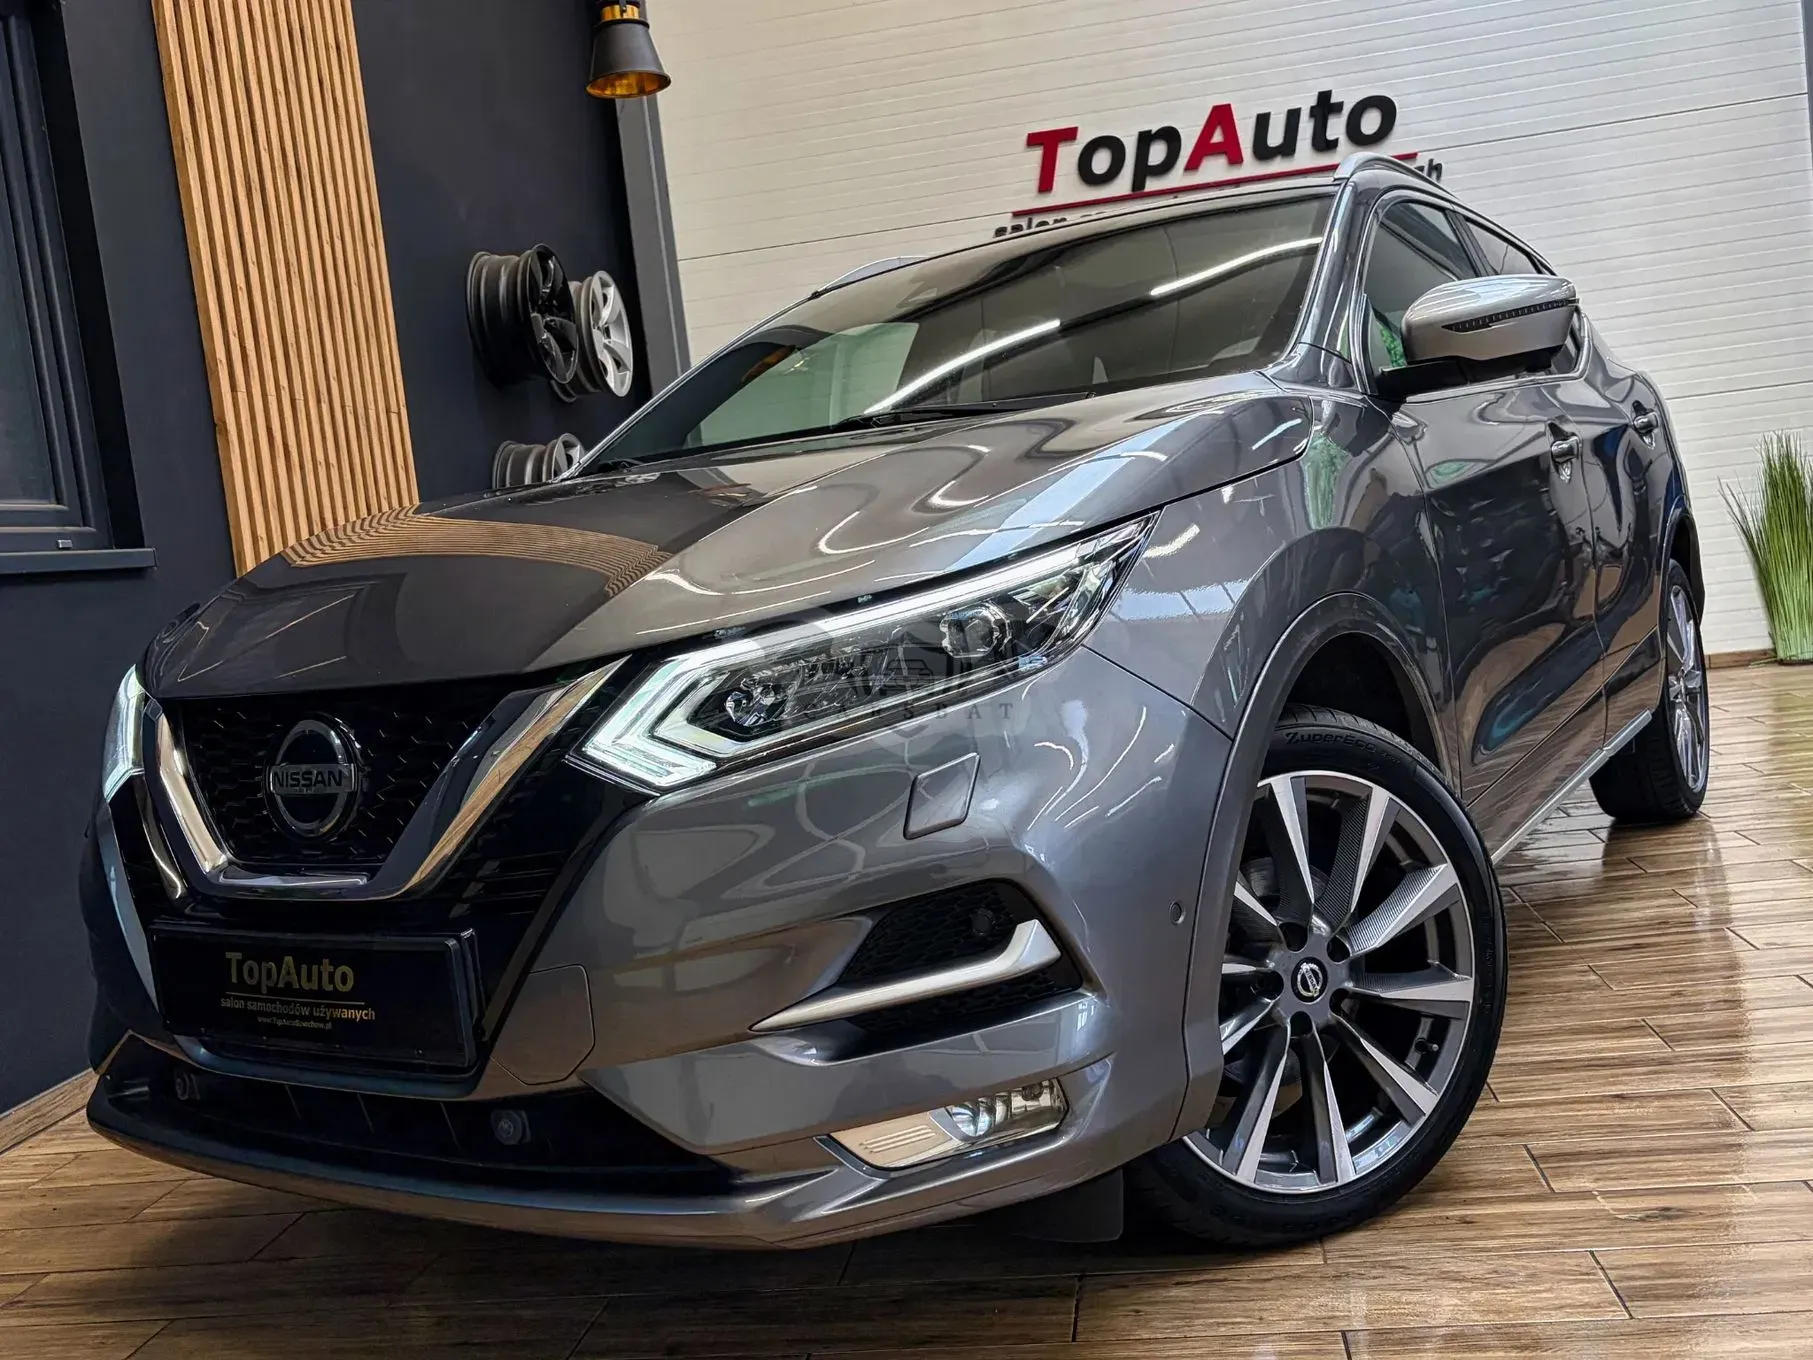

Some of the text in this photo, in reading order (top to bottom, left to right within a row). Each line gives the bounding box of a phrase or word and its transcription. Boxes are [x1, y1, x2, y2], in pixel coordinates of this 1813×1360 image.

[1026, 89, 1397, 193] TopAuto
[272, 770, 342, 788] NISSAN
[225, 952, 354, 993] TopAuto
[221, 996, 376, 1022] salon samochodów używanych
